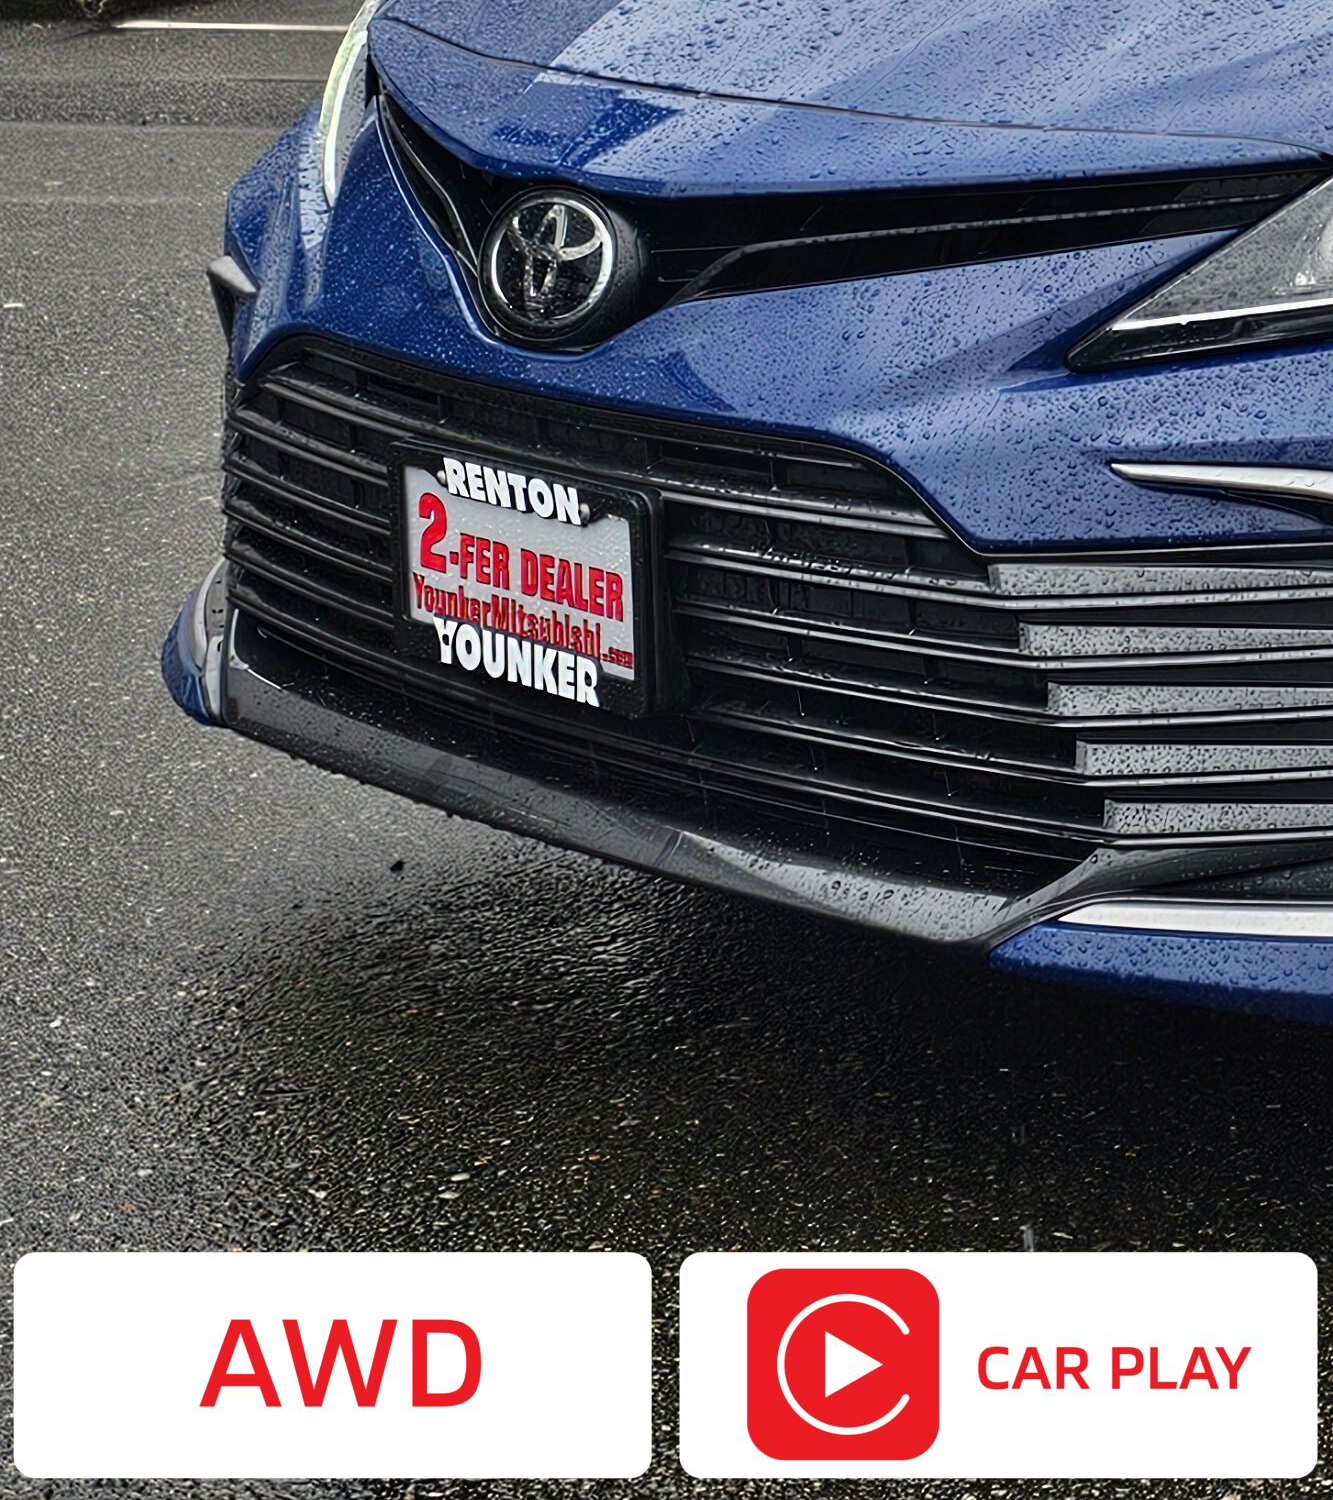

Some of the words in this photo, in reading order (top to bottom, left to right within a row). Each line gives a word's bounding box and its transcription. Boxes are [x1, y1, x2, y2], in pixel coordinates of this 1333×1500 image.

[443, 457, 582, 526] RENTON
[418, 492, 510, 591] 2-FER
[520, 548, 624, 622] DEALER
[432, 616, 601, 708] YOUNKER
